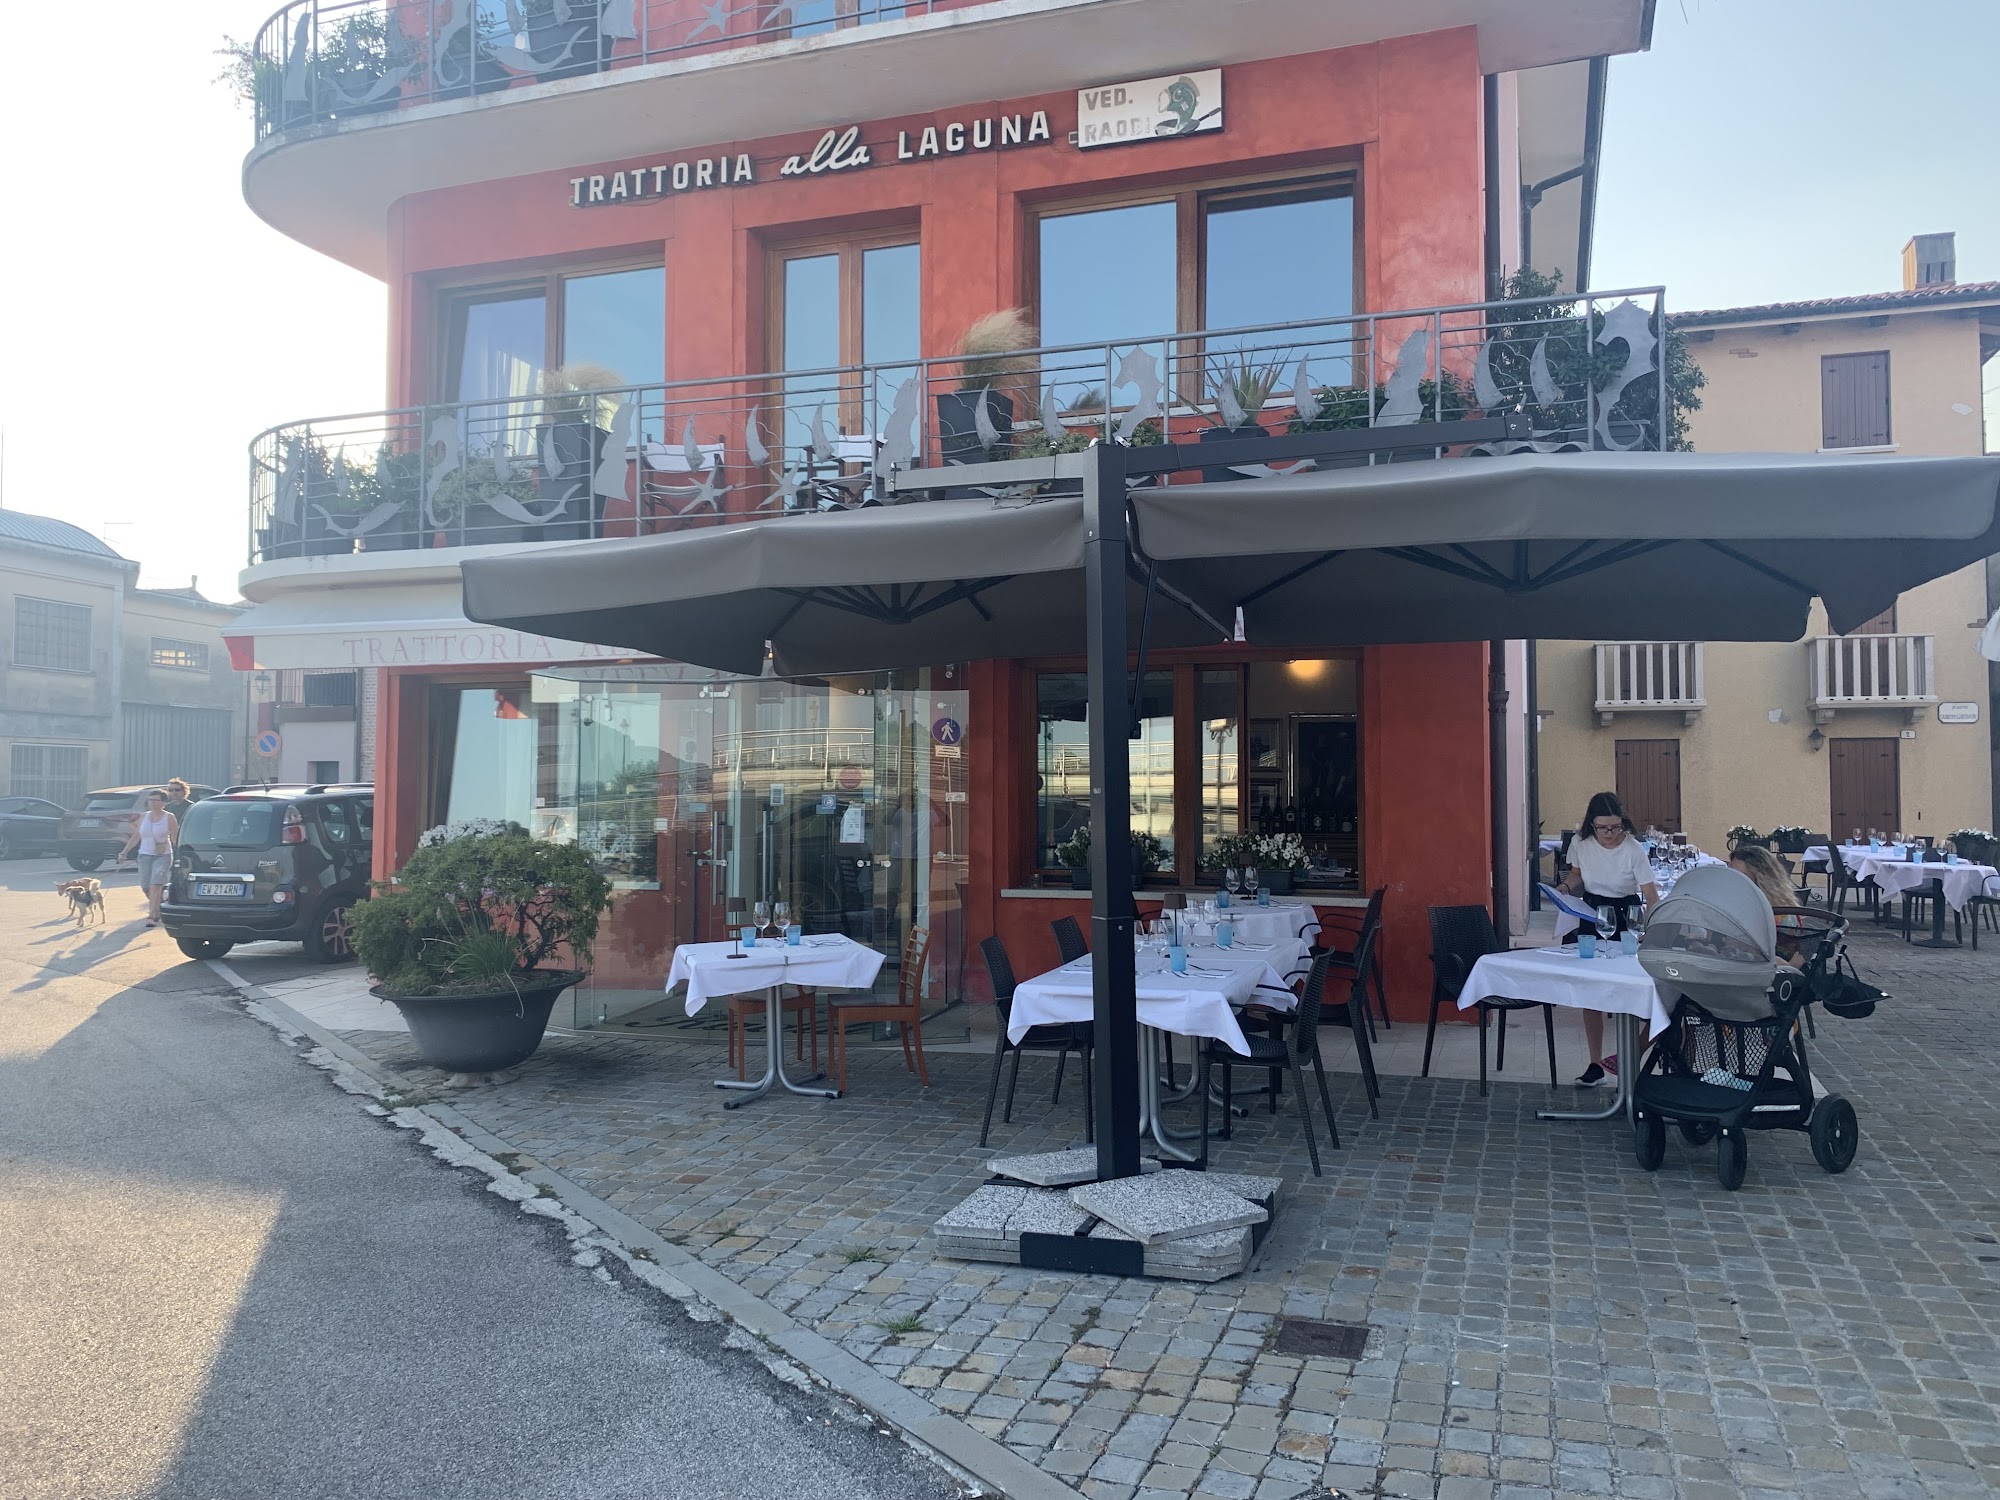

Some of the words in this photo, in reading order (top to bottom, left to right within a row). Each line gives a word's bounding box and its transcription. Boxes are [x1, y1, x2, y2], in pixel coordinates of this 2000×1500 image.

[1084, 87, 1134, 111] VED.
[569, 153, 753, 205] TRATTORIA
[780, 125, 871, 175] alla
[898, 110, 1050, 159] LAGUNA
[342, 632, 553, 665] TRATTORIA
